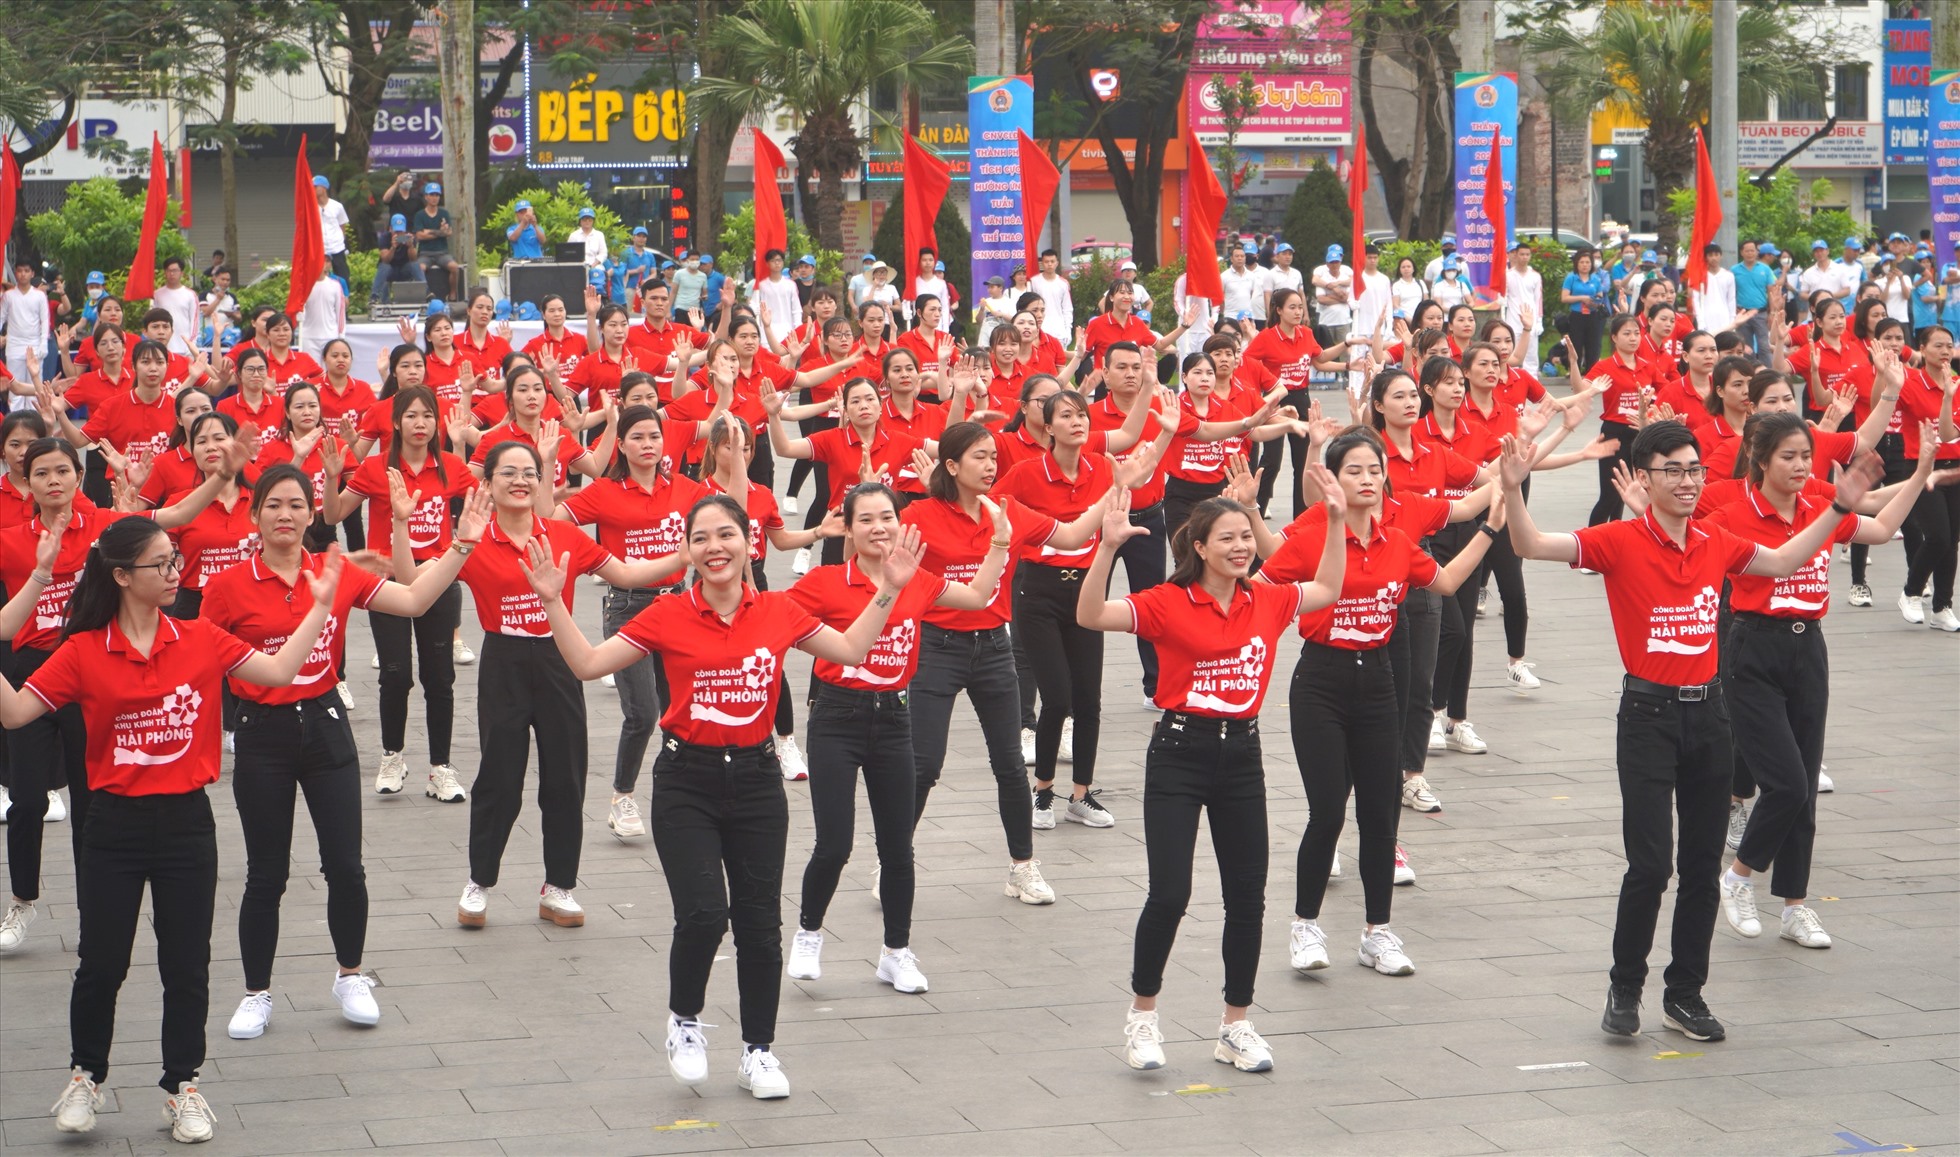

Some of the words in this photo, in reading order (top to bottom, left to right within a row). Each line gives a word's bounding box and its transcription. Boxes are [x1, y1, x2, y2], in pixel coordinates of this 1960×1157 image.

[1888, 29, 1931, 53] TRANG
[539, 73, 624, 142] BẾP
[633, 88, 687, 142] 68
[1458, 135, 1487, 146] CÔNG
[975, 146, 1007, 158] THÀNH
[1007, 147, 1020, 158] PH
[980, 163, 1002, 175] TÍCH
[974, 180, 1009, 191] HƯỚNG
[1009, 179, 1022, 191] ỨN
[981, 214, 1002, 225] VĂN
[1003, 214, 1023, 225] HÓA
[981, 229, 999, 242] THỂ
[999, 233, 1023, 242] THAO
[1463, 238, 1490, 249] ĐOÀN
[1011, 250, 1027, 259] 202
[1183, 453, 1198, 461] HẢI
[1200, 451, 1225, 461] PHÒNG
[410, 522, 441, 534] PHÒNG
[626, 528, 643, 537] CÔNG
[643, 527, 661, 535] ĐOÀN
[638, 535, 654, 543] KINH
[654, 533, 663, 541] TẾ
[221, 547, 238, 555] ĐOÀN
[626, 543, 646, 556] HẢI
[215, 554, 231, 562] KINH
[231, 553, 240, 561] TẾ
[201, 562, 222, 575] HẢI
[1790, 573, 1811, 582] KINH
[56, 580, 75, 590] ĐOÀN
[1774, 581, 1797, 596] HẢI
[1798, 579, 1830, 593] PHÒN
[38, 593, 51, 601] HU
[51, 590, 69, 599] KINH
[501, 594, 521, 603] CÔNG
[521, 592, 539, 602] ĐOÀN
[500, 603, 514, 612] KHU
[515, 602, 533, 610] KINH
[533, 600, 541, 609] TẾ
[1337, 598, 1357, 606] CÔNG
[37, 601, 59, 616] HẢI
[1334, 606, 1350, 614] KHU
[1350, 605, 1369, 613] KINH
[1368, 603, 1378, 612] TẾ
[1652, 606, 1674, 614] CÔNG
[1675, 605, 1695, 614] ĐOÀN
[501, 611, 524, 626] HẢI
[525, 609, 548, 624] PHÒ
[1333, 613, 1357, 627] HẢI
[1649, 615, 1668, 623] KHU
[1668, 614, 1688, 622] KINH
[1688, 611, 1698, 621] TẾ
[1650, 622, 1677, 638] HẢI
[264, 636, 286, 646] CÔNG
[882, 641, 893, 651] TẾ
[261, 646, 275, 655] KHU
[870, 652, 908, 667] PHÒNG
[1196, 658, 1218, 668] CÔNG
[1219, 657, 1241, 666] ĐOÀN
[694, 669, 717, 678] CÔNG
[718, 668, 742, 677] ĐOÀN
[1193, 669, 1211, 678] KHU
[1211, 667, 1232, 676] KINH
[1231, 664, 1243, 675] TẾ
[693, 679, 710, 688] KHU
[711, 678, 732, 687] KINH
[732, 676, 745, 686] TẾ
[1192, 675, 1221, 692] HẢI
[1221, 674, 1260, 691] PHÒNG
[693, 688, 718, 704] HẢI
[721, 687, 768, 704] PHÒNG
[115, 710, 139, 722] CÔNG
[139, 707, 164, 718] ĐOÀN
[114, 720, 133, 731] KHU
[133, 718, 155, 727] KINH
[155, 715, 167, 726] TẾ
[116, 729, 144, 747] HẢI
[145, 725, 193, 745] PHÒNG
